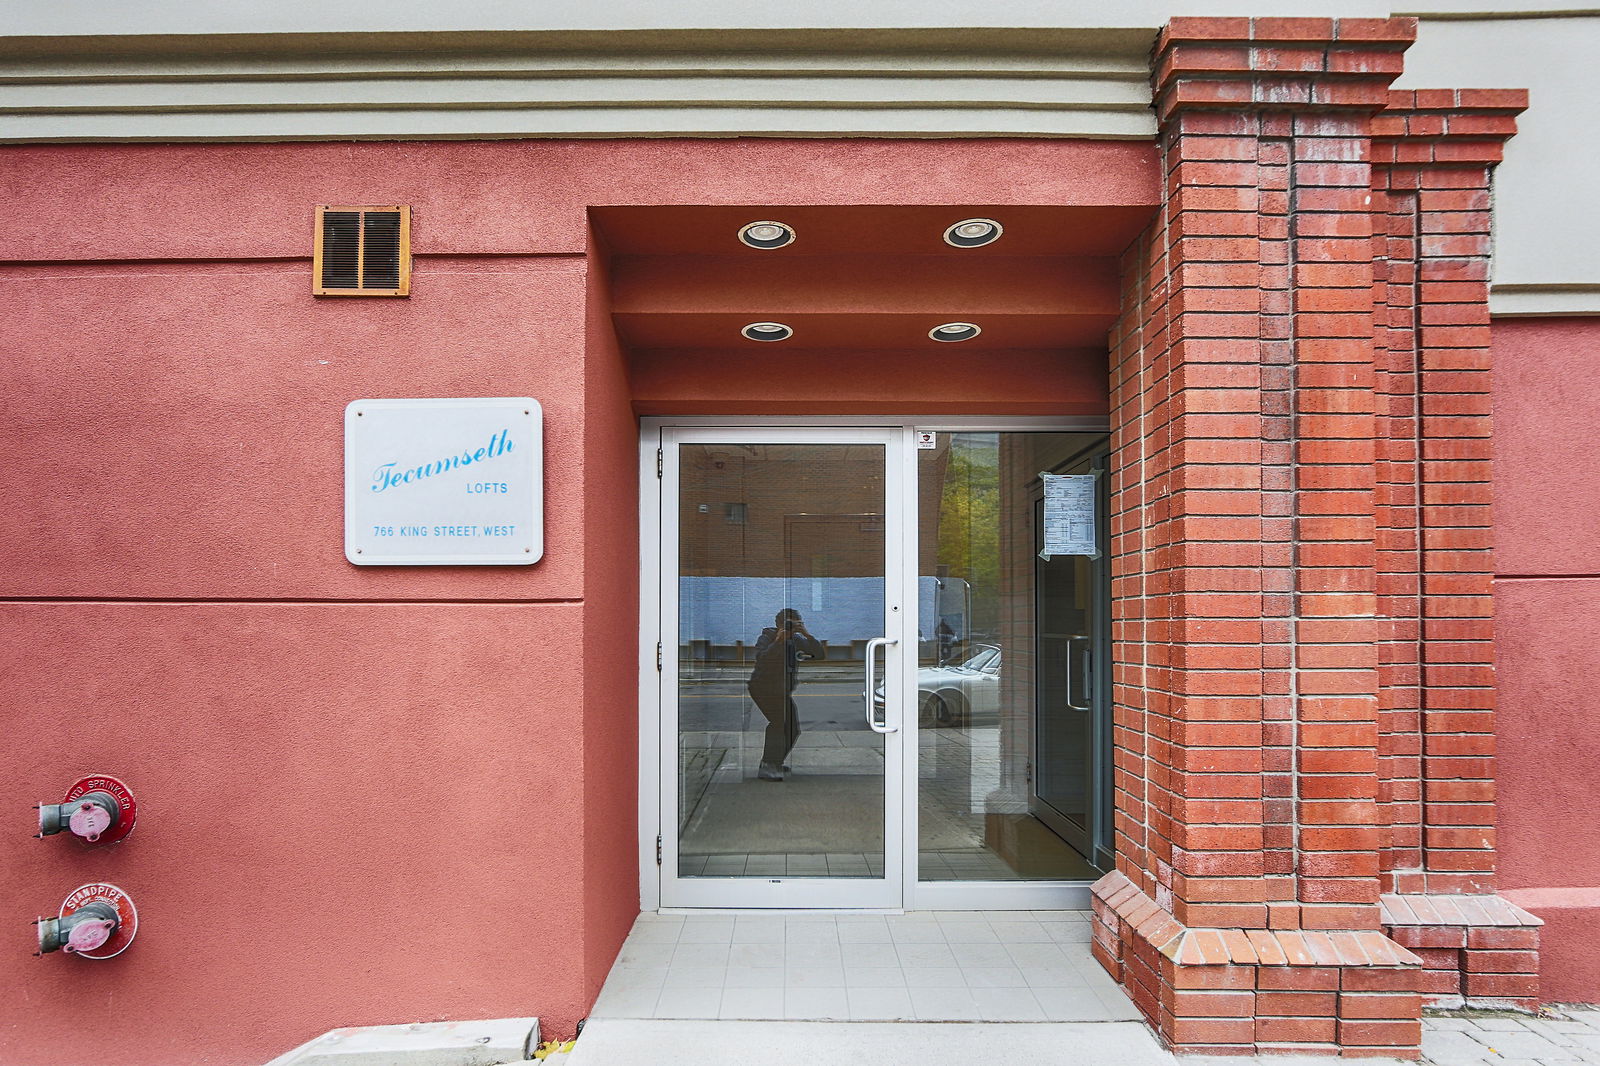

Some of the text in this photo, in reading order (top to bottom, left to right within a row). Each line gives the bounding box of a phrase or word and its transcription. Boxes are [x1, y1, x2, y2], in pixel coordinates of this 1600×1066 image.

[371, 428, 516, 493] Tecumseth
[466, 482, 509, 494] LOFTS
[373, 526, 394, 537] 766
[400, 526, 428, 537] KING
[483, 525, 516, 537] WEST
[87, 779, 131, 811] SPRINKLER
[66, 886, 123, 911] STANDPIPE
